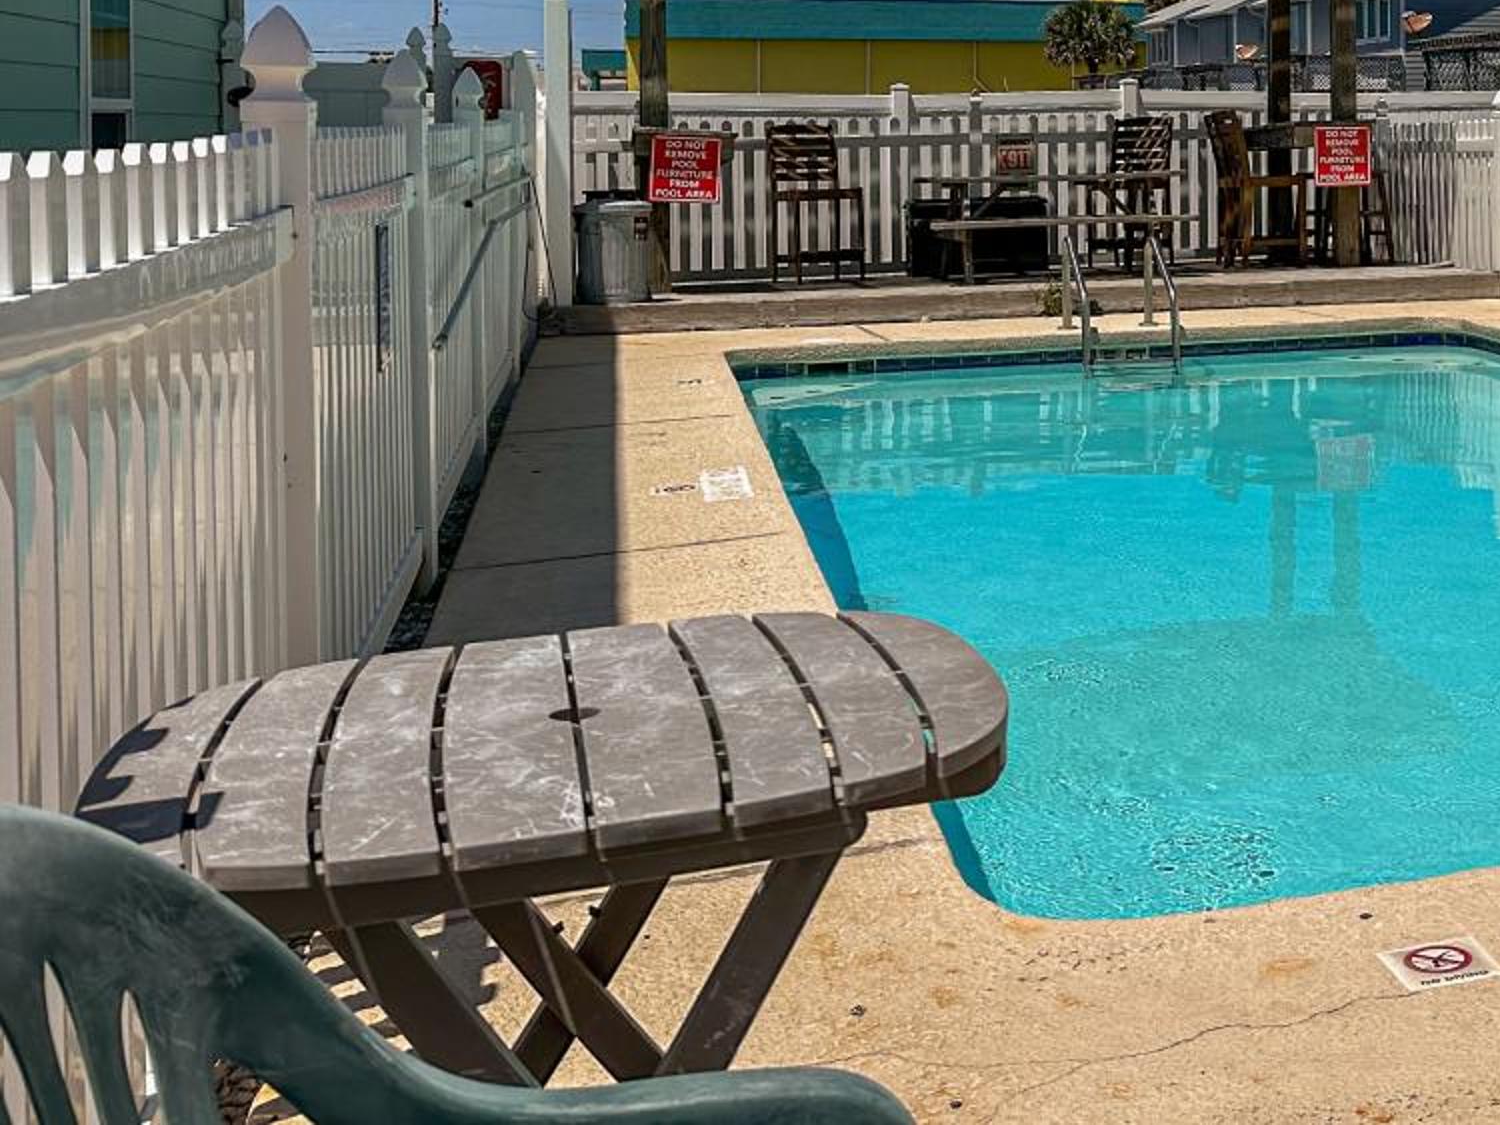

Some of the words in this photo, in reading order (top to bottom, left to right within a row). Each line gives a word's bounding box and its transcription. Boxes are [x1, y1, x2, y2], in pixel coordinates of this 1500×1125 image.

[665, 140, 682, 149] DO
[684, 140, 706, 150] NOT
[665, 150, 706, 160] REMOVE
[671, 160, 698, 169] POOL
[656, 169, 713, 180] FURNITURE
[669, 179, 700, 187] FROM
[655, 188, 683, 197] POOL
[685, 189, 713, 198] AREA
